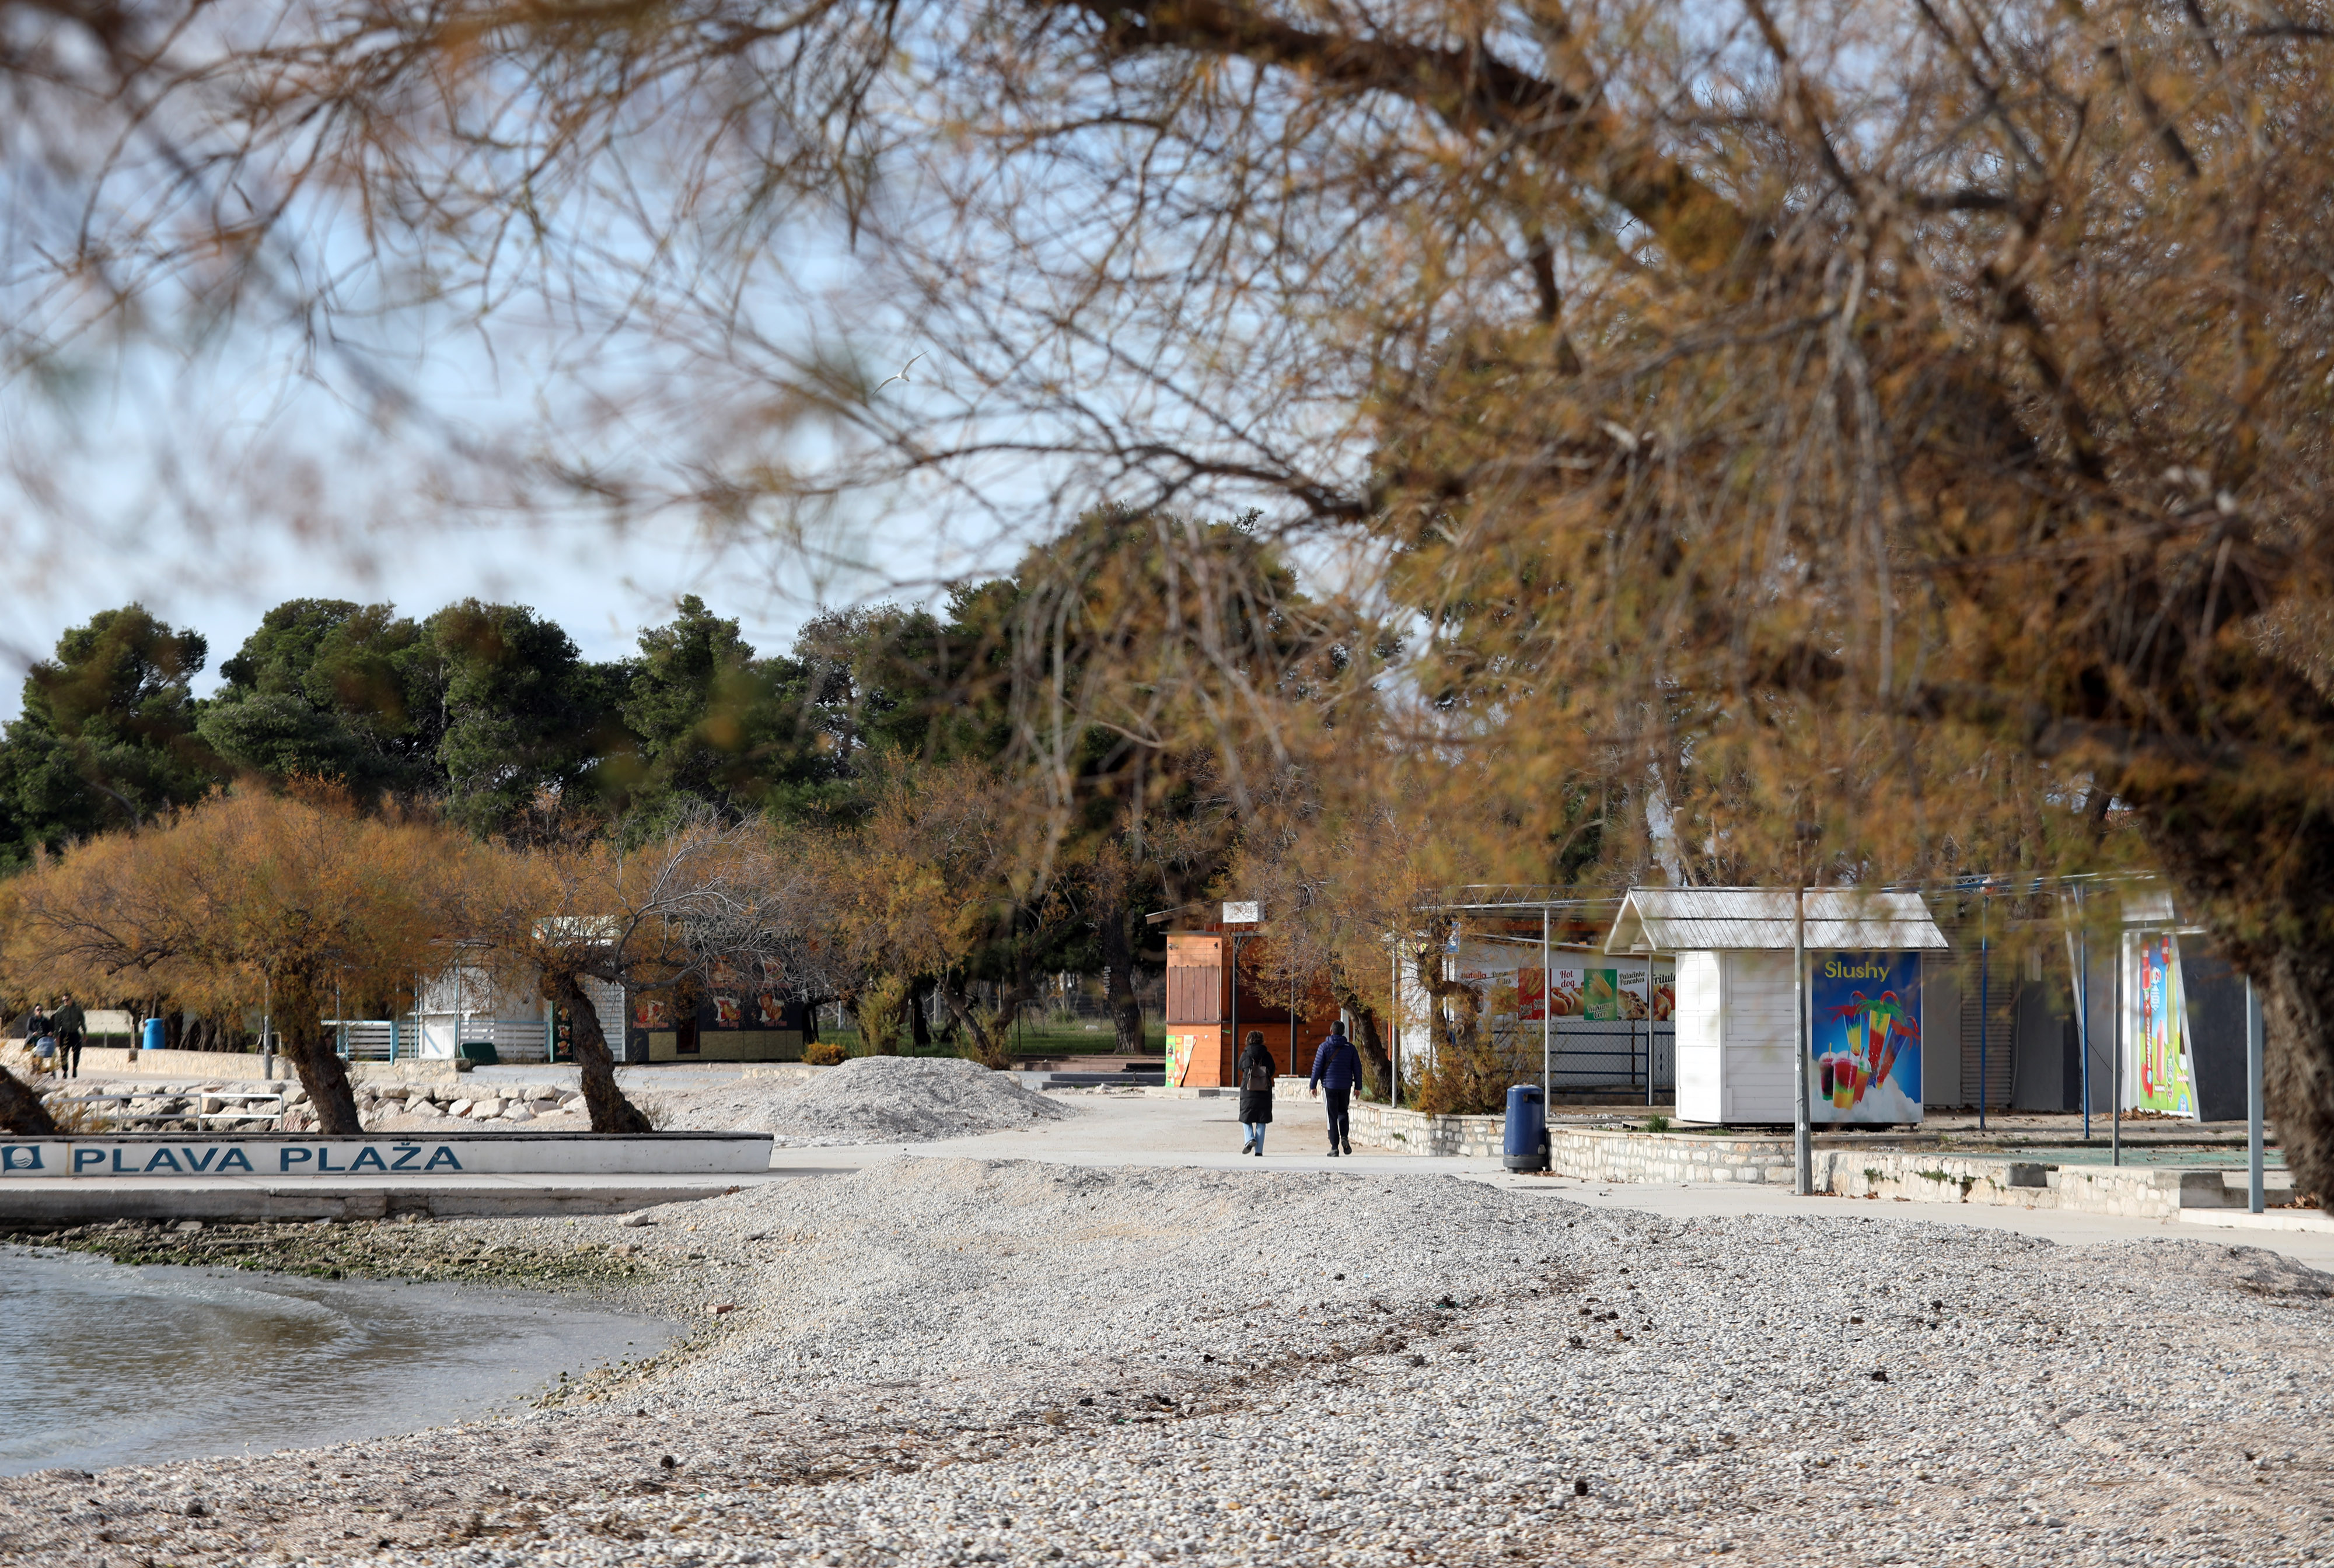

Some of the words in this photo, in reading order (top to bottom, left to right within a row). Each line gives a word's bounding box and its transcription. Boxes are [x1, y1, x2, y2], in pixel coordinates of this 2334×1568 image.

[1560, 970, 1574, 979] Hot
[1825, 961, 1891, 982] Slushy
[1561, 980, 1575, 989] dog
[1619, 977, 1645, 986] Pancakes
[1594, 1011, 1608, 1020] Corn
[74, 1147, 254, 1172] PLAVA
[279, 1142, 463, 1172] PLAŽA
